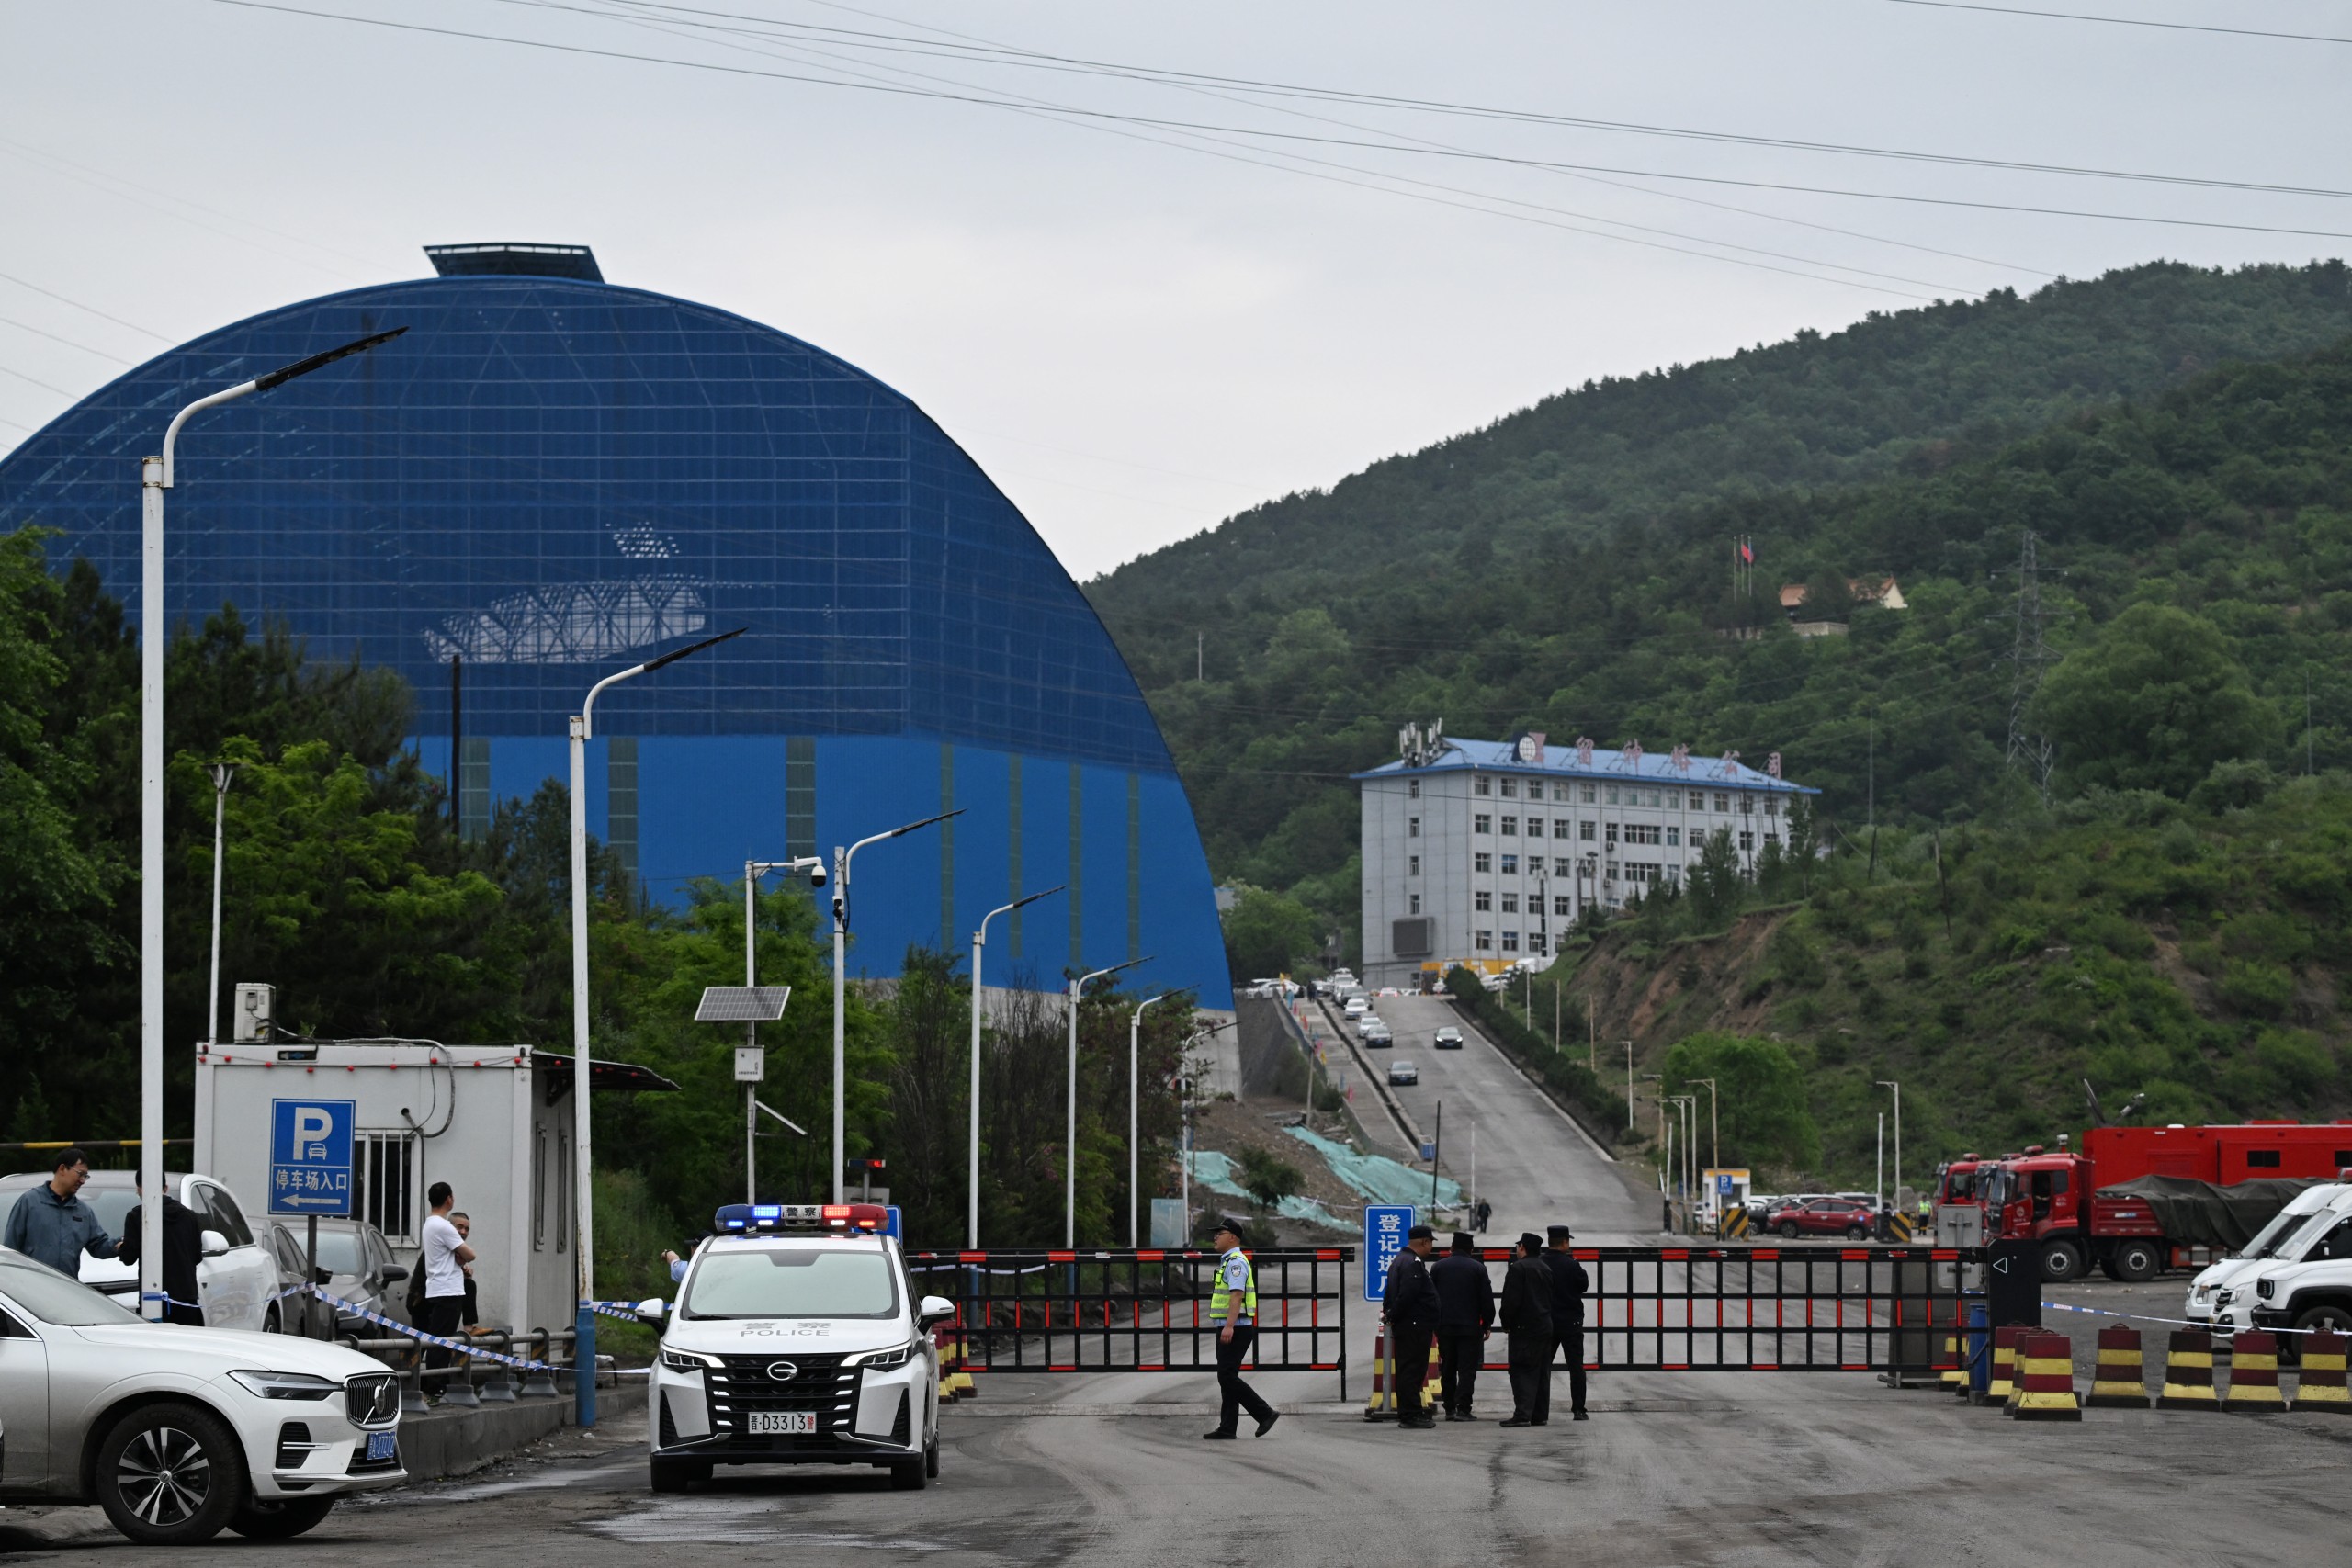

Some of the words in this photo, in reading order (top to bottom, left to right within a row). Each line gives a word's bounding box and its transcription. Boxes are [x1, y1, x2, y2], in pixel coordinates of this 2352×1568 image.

[293, 1107, 333, 1160] P
[276, 1169, 347, 1190] 停车场入口
[786, 1207, 817, 1216] 警察
